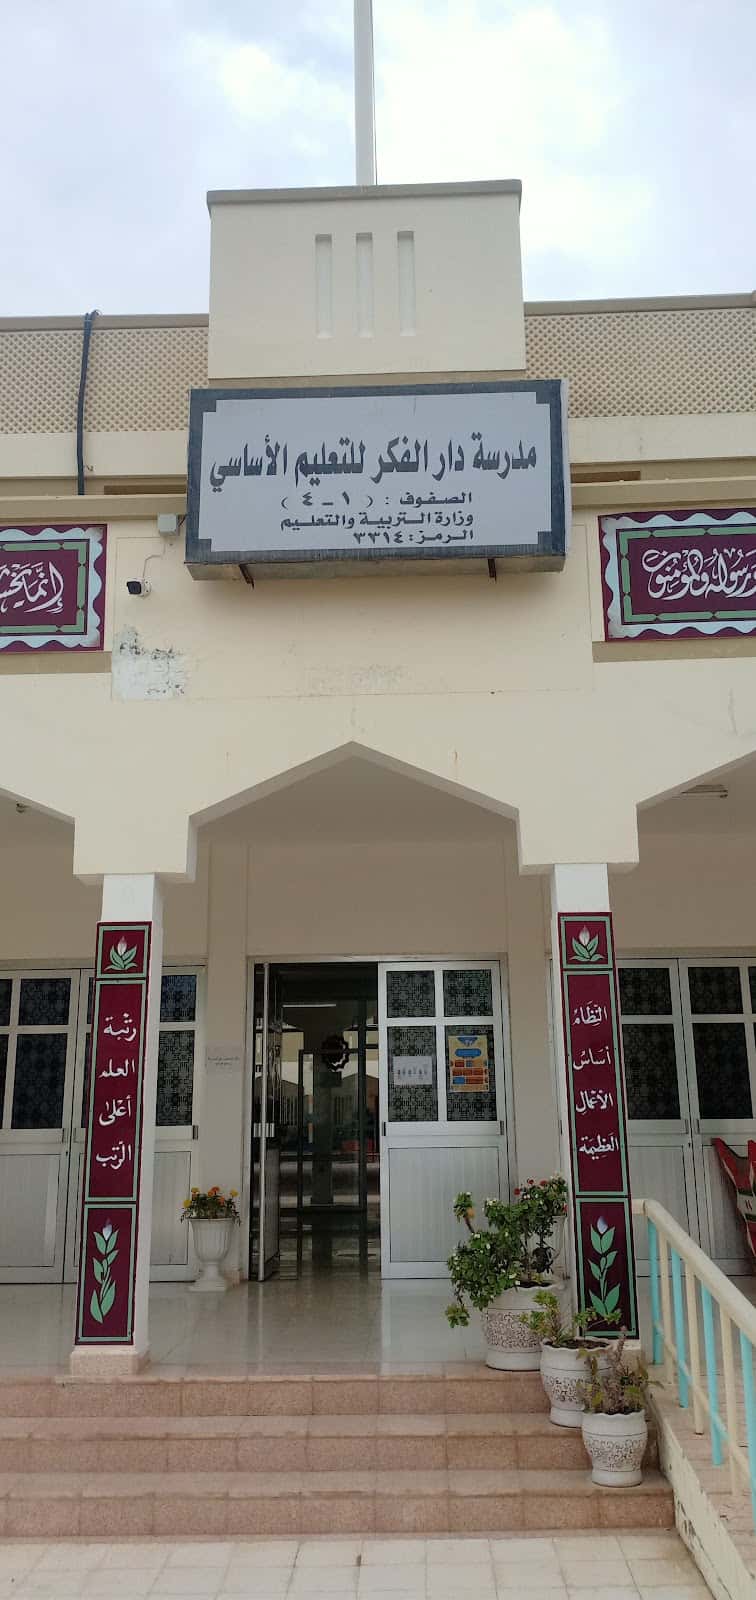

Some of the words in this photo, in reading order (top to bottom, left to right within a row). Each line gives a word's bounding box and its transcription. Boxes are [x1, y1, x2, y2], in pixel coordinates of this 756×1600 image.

[209, 433, 288, 493] الأساسي
[294, 436, 367, 489] للتعليم
[370, 435, 429, 485] الفكر
[431, 439, 465, 482] دار
[471, 431, 537, 480] مدرسة
[358, 511, 432, 529] التربية
[399, 491, 473, 509] الصفوف
[434, 511, 474, 527] وزارة
[280, 512, 356, 532] والتعليم
